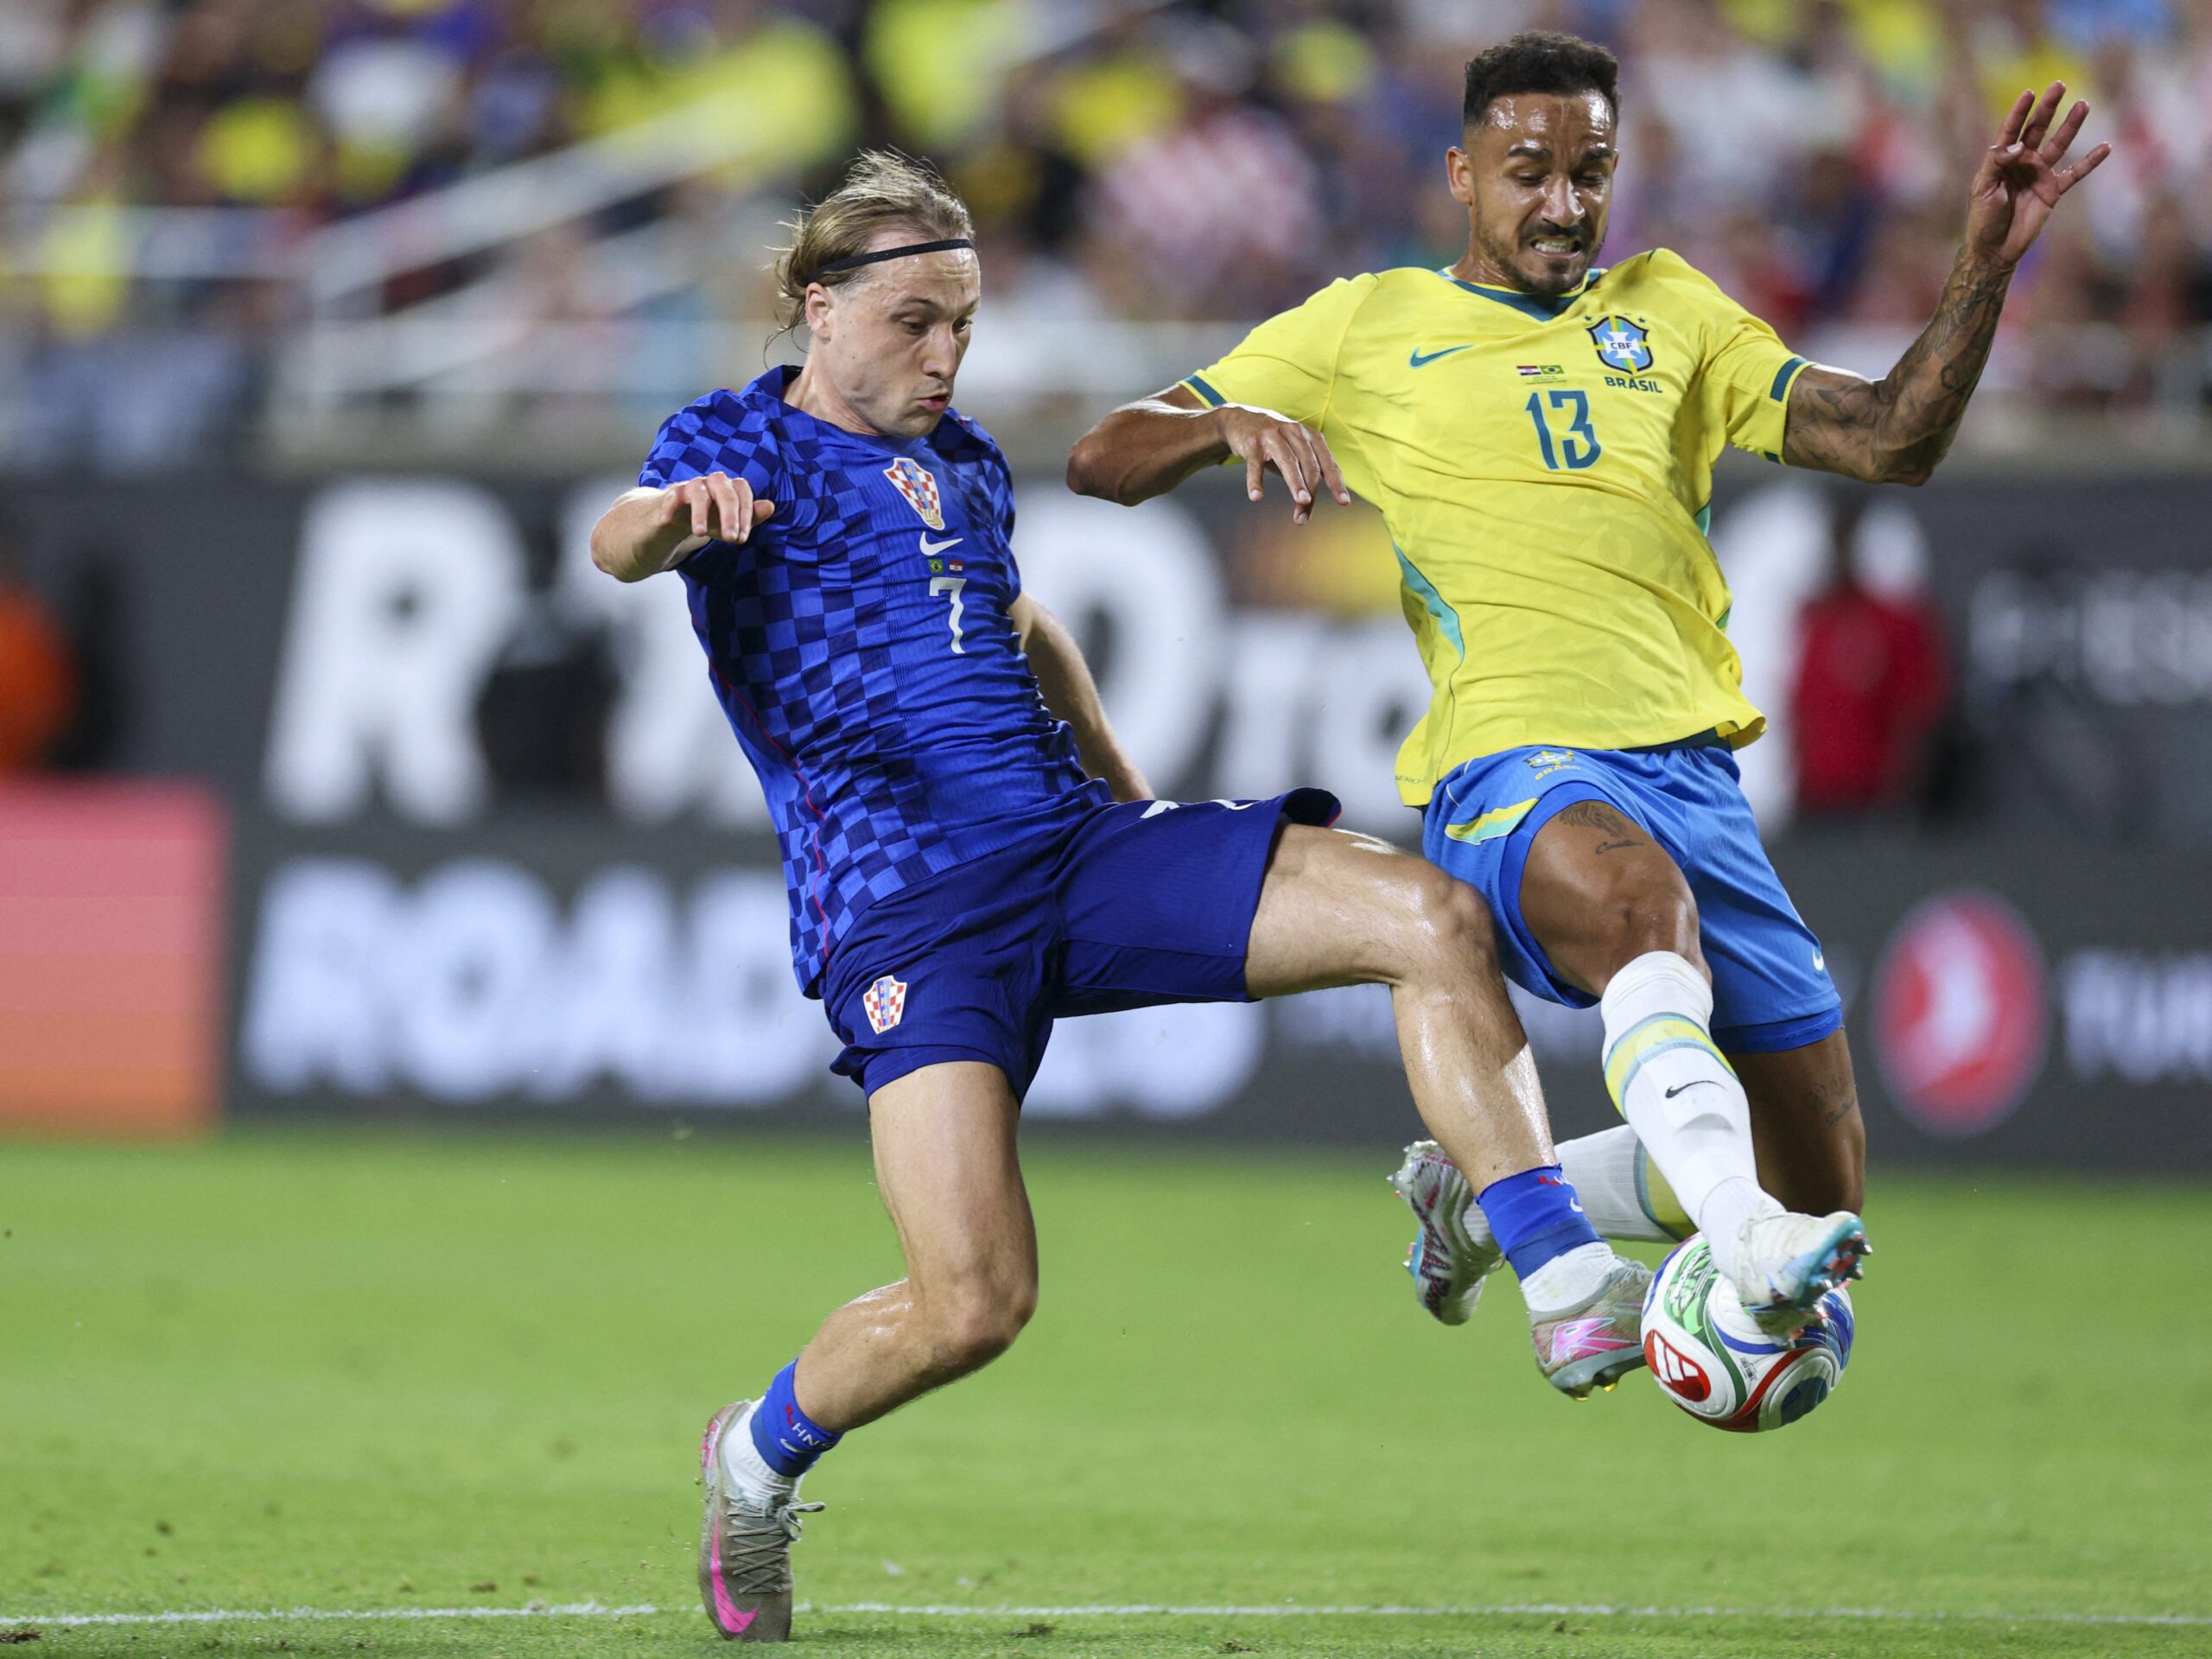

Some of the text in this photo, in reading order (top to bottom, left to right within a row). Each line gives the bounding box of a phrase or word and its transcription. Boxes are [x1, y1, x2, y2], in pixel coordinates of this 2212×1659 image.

[1605, 376, 1663, 393] BRASIL
[1524, 390, 1602, 470] 13
[928, 575, 968, 655] 7
